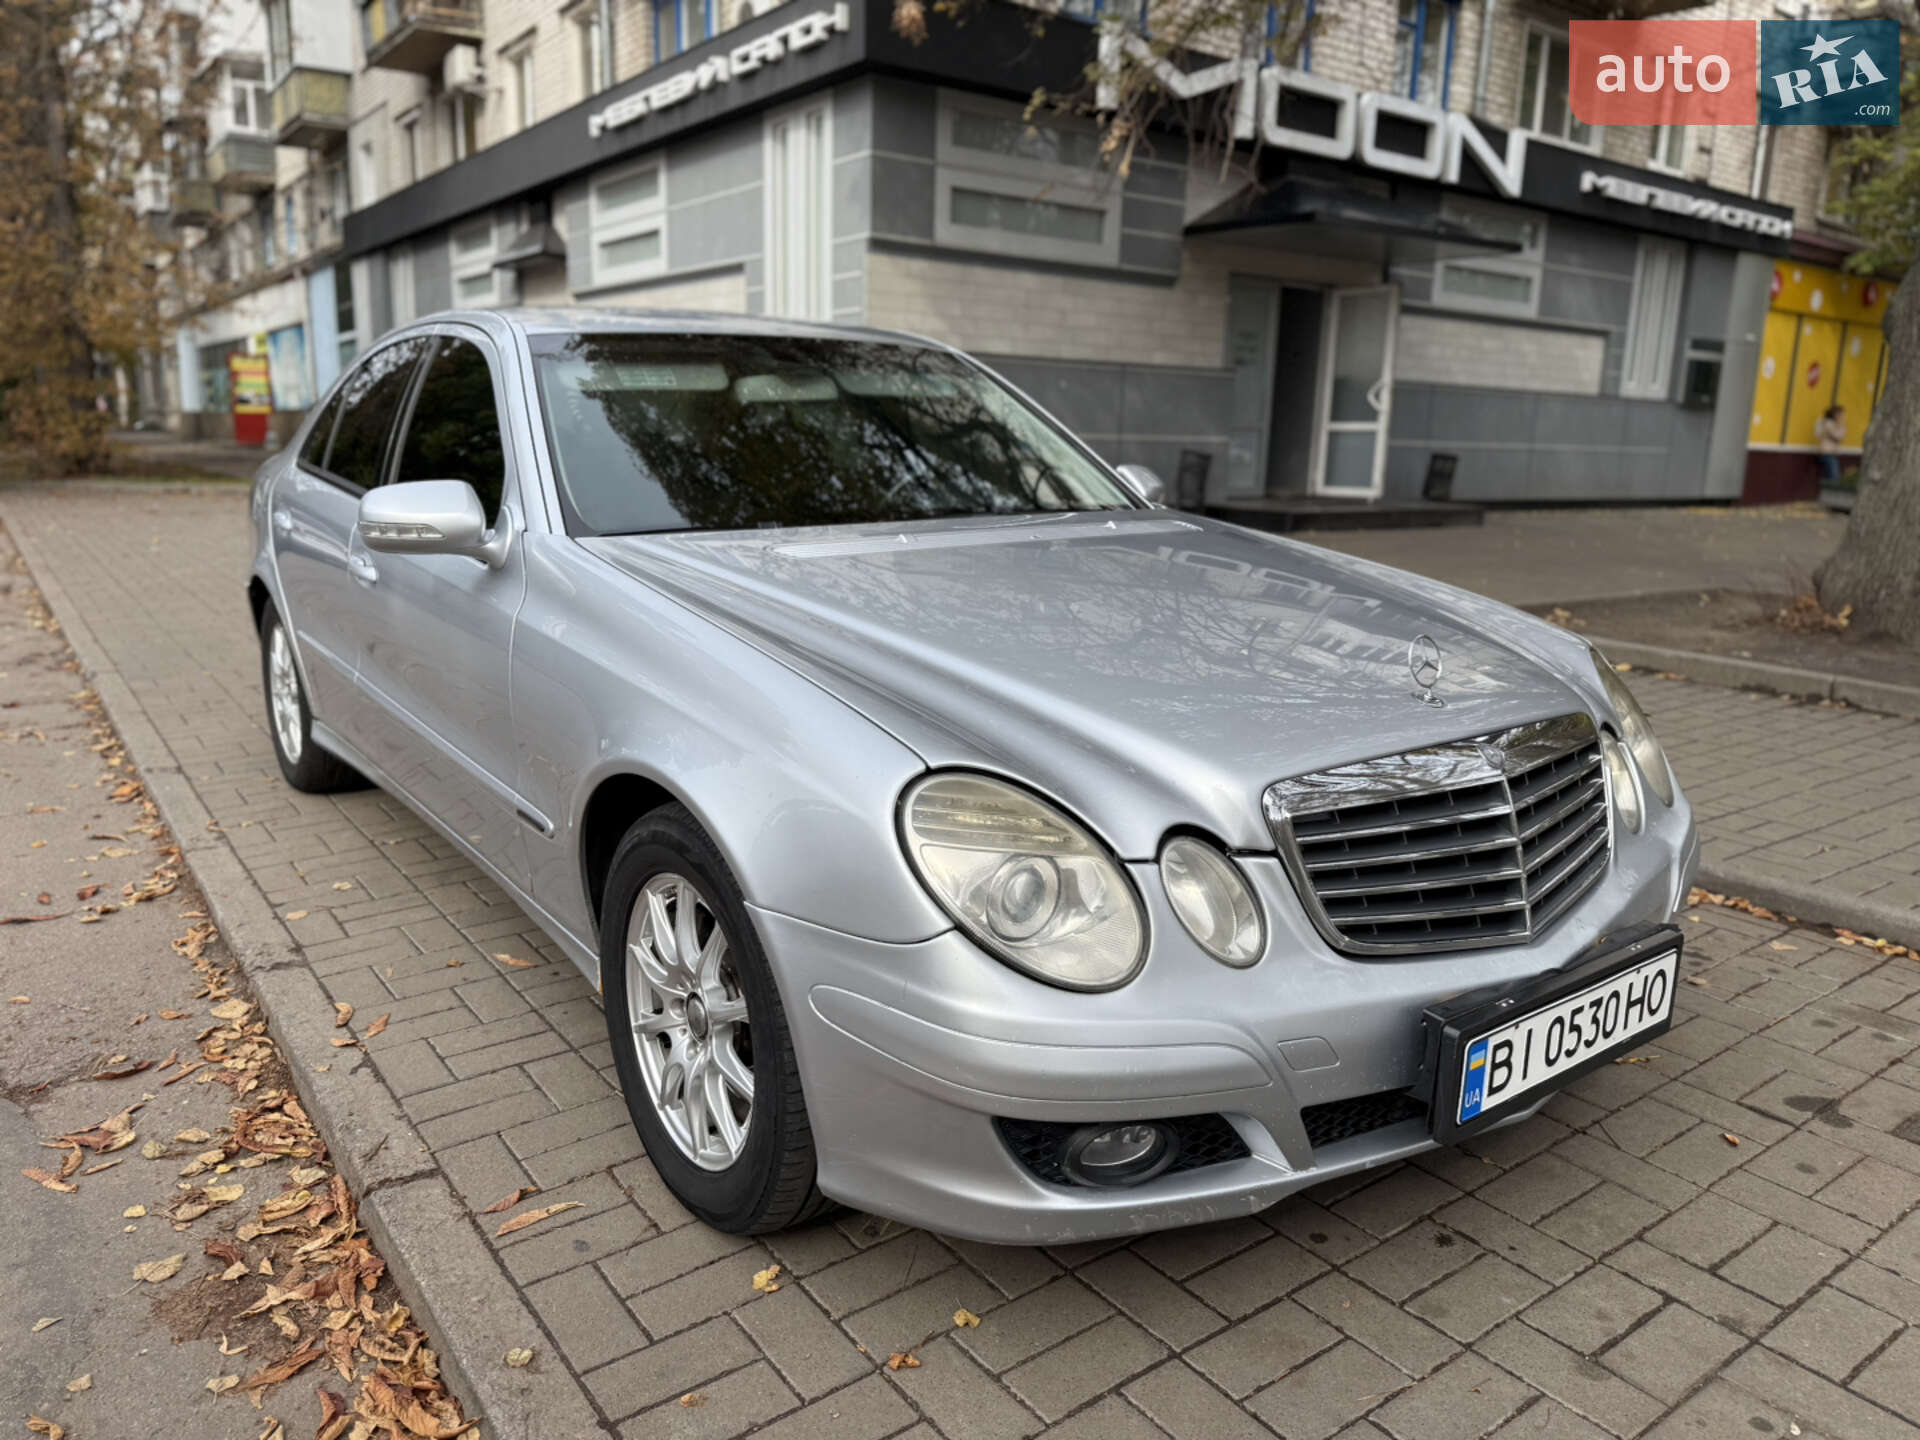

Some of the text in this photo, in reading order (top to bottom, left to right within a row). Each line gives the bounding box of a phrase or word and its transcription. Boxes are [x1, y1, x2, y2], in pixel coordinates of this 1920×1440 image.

[1096, 21, 1528, 197] MOON
[1464, 1088, 1481, 1108] UA
[1486, 969, 1668, 1098] BI 0530 HO
